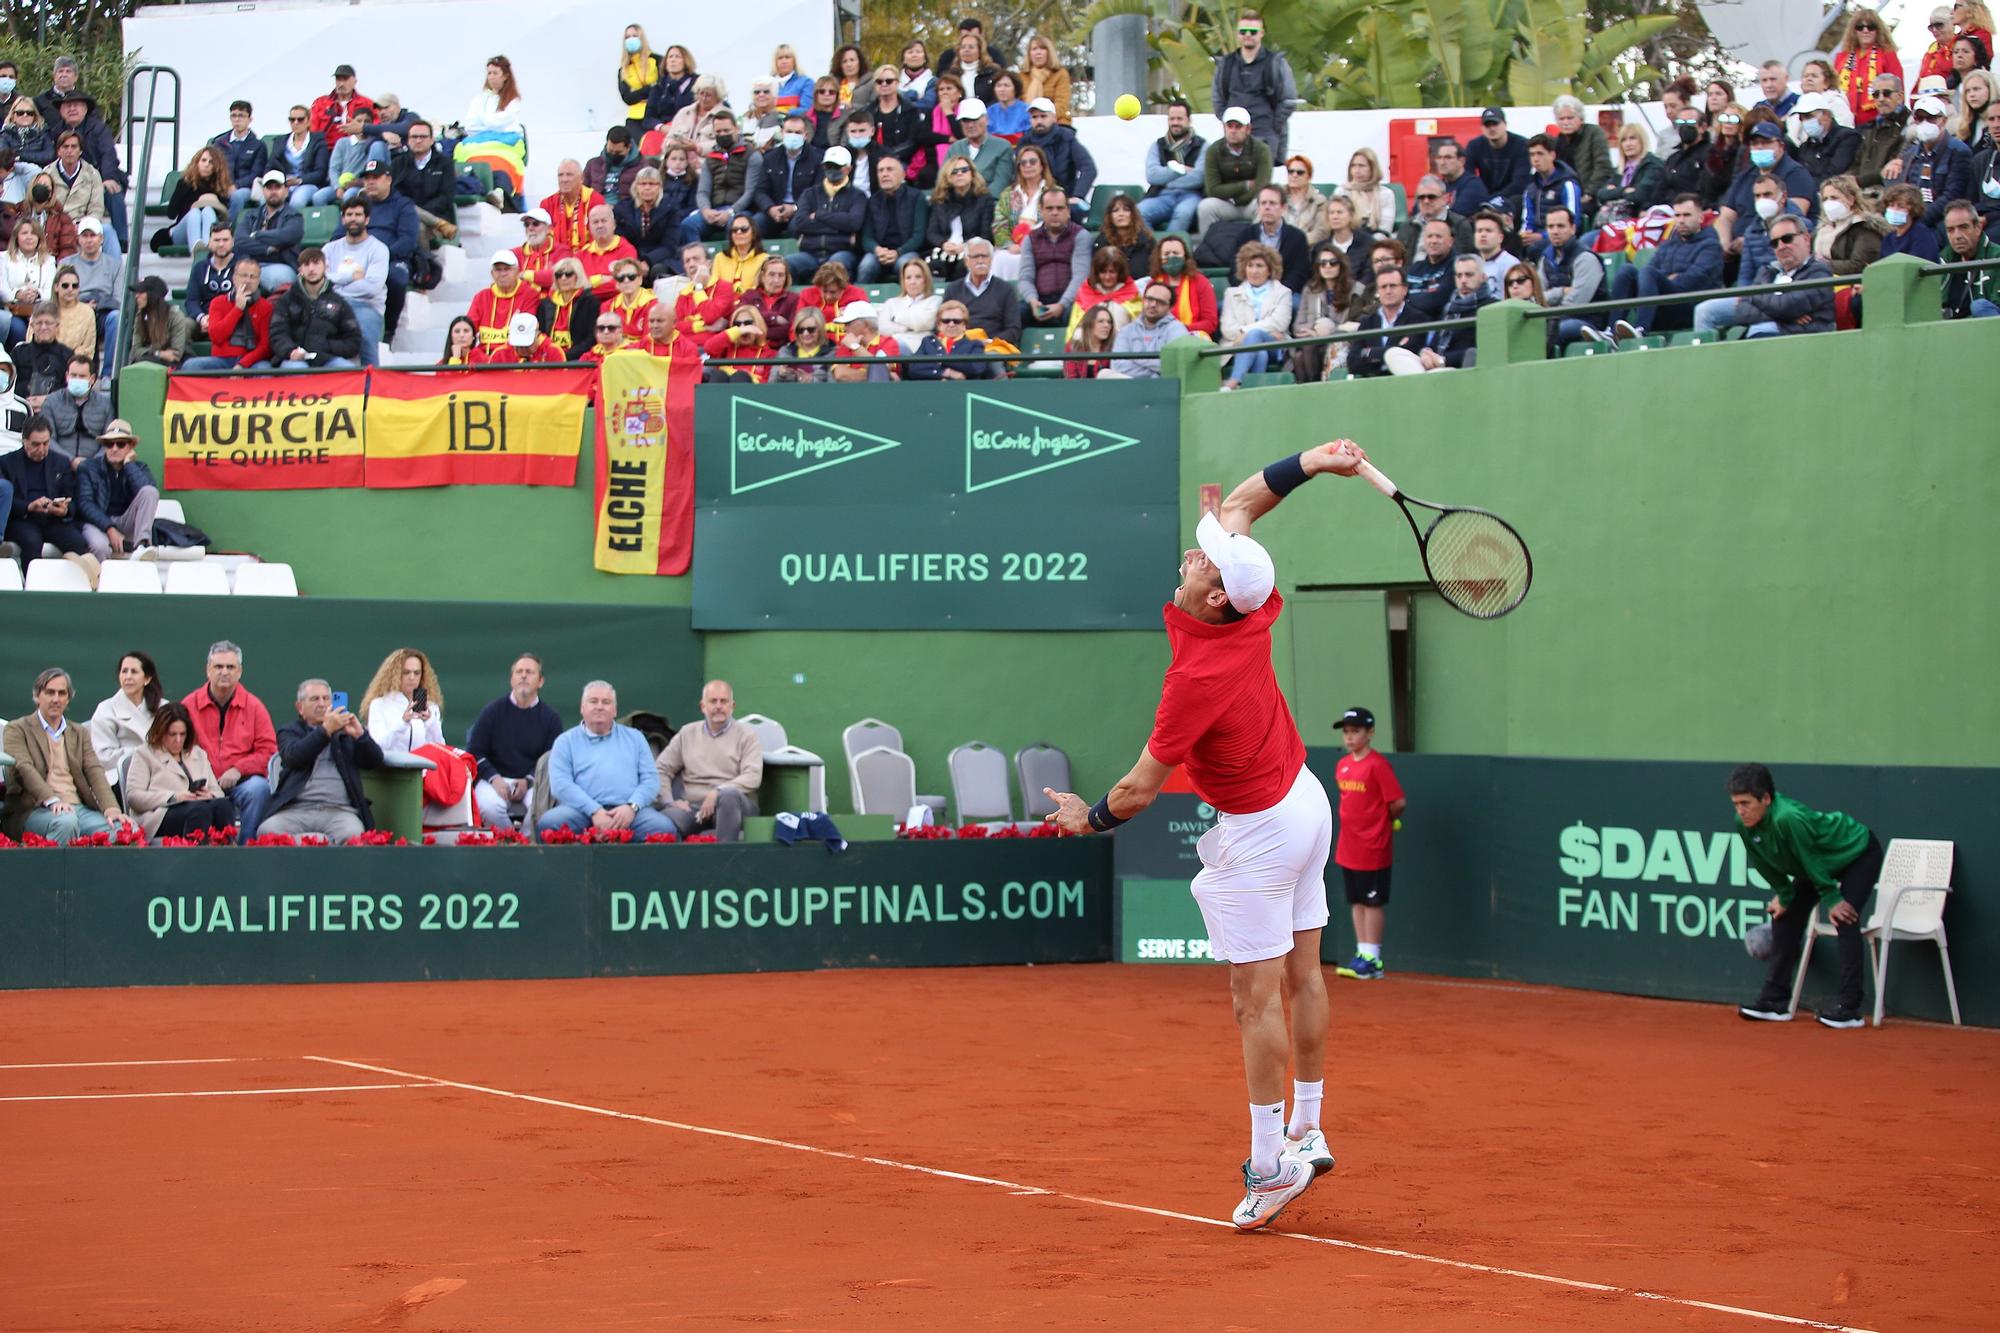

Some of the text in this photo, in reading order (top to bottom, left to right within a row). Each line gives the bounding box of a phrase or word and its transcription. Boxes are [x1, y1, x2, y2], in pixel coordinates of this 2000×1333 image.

[210, 390, 333, 409] Carlitos
[169, 407, 358, 445] MURCIA
[973, 426, 1091, 456] El Corte Inglés
[188, 448, 331, 468] TE QUIERE
[737, 428, 853, 459] El Corte Inglés
[607, 459, 648, 552] ELCHE
[780, 552, 1089, 586] QUALIFIERS 2022
[1168, 821, 1210, 833] DAVIS
[1559, 820, 1773, 890] $DAVI
[147, 892, 521, 939] QUALIFIERS 2022
[611, 880, 1085, 931] DAVISCUPFINALS.COM
[1558, 887, 1772, 941] FAN TOKE
[1137, 938, 1186, 959] SERVE
